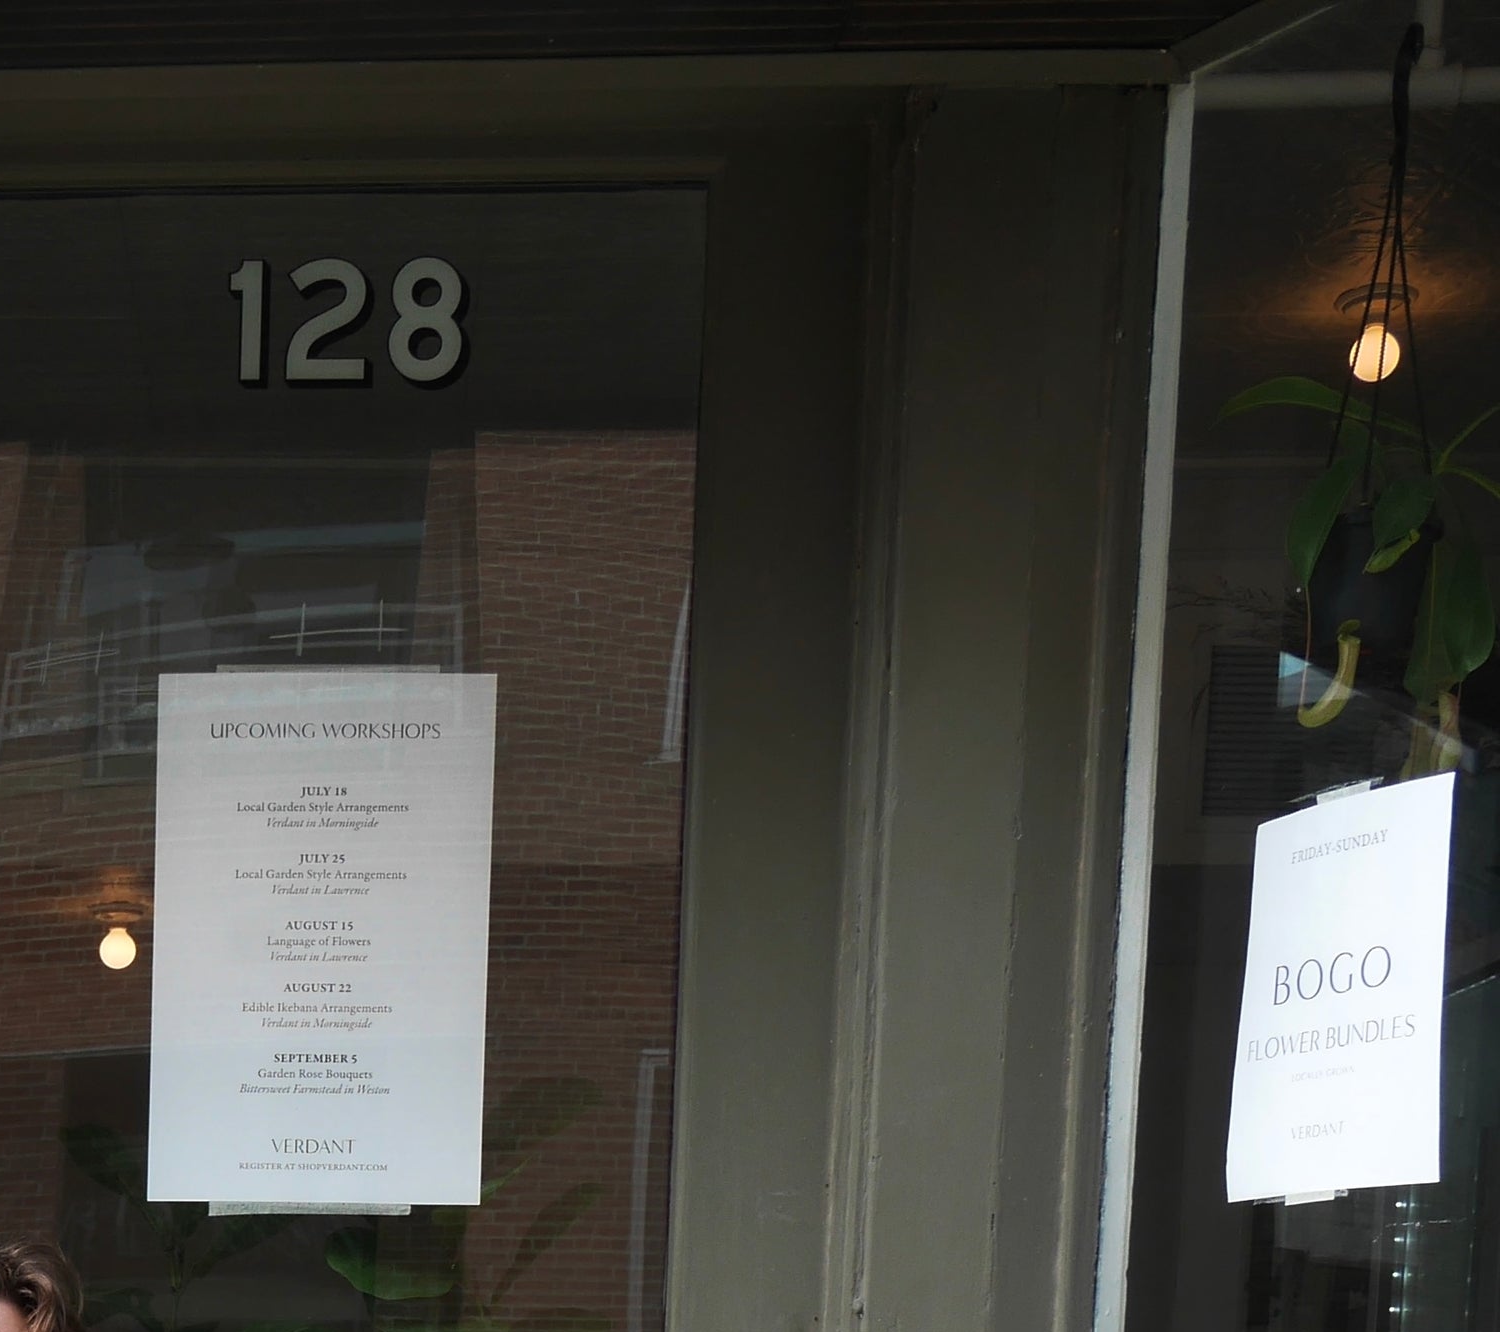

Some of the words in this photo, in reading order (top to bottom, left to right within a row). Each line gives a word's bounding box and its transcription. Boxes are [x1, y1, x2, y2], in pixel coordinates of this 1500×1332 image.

[229, 256, 466, 385] 128
[211, 722, 316, 740] UPCOMING
[322, 722, 441, 740] WORKSHOPS
[300, 786, 331, 799] JULY
[335, 786, 348, 797] 18
[236, 801, 265, 813] Local
[267, 801, 306, 813] Garden
[308, 801, 334, 815] Style
[336, 802, 409, 816] Arrangements
[267, 817, 304, 828] Verdant
[306, 817, 316, 828] in
[318, 817, 379, 831] Morningside
[1291, 829, 1388, 865] FRIDAY-SUNDAY
[298, 854, 330, 867] JULY
[332, 854, 346, 865] 25
[235, 868, 264, 880] Local
[266, 868, 304, 880] Garden
[307, 868, 331, 883] Style
[334, 869, 407, 883] Arrangements
[272, 884, 309, 896] Verdant
[311, 884, 321, 896] in
[323, 884, 370, 896] Lawrence
[285, 920, 338, 932] AUGUST
[342, 920, 354, 932] 15
[267, 935, 317, 949] Language
[318, 935, 330, 948] of
[332, 935, 371, 948] Flowers
[270, 950, 307, 962] Verdant
[309, 950, 319, 962] in
[321, 950, 368, 962] Lawrence
[1273, 945, 1391, 1006] BOGO
[284, 982, 336, 993] AUGUST
[339, 983, 352, 993] 22
[242, 1002, 275, 1013] Edible
[277, 1002, 318, 1013] Ikebana
[320, 1003, 393, 1018] Arrangements
[261, 1017, 298, 1029] Verdant
[300, 1017, 311, 1029] in
[312, 1017, 373, 1032] Morningside
[1247, 1030, 1320, 1062] FLOWER
[1325, 1014, 1416, 1051] BUNDLES
[274, 1053, 348, 1065] SEPTEMBER
[351, 1054, 358, 1065] 5
[257, 1068, 296, 1079] Garden
[299, 1068, 323, 1080] Rose
[325, 1068, 373, 1083] Bouquets
[293, 1083, 343, 1095] Farmstead
[344, 1083, 354, 1095] in
[356, 1083, 390, 1095] Weston
[1291, 1120, 1345, 1140] VERDANT
[271, 1138, 357, 1155] VERDANT
[239, 1161, 283, 1171] REGISTER
[284, 1161, 296, 1171] AT
